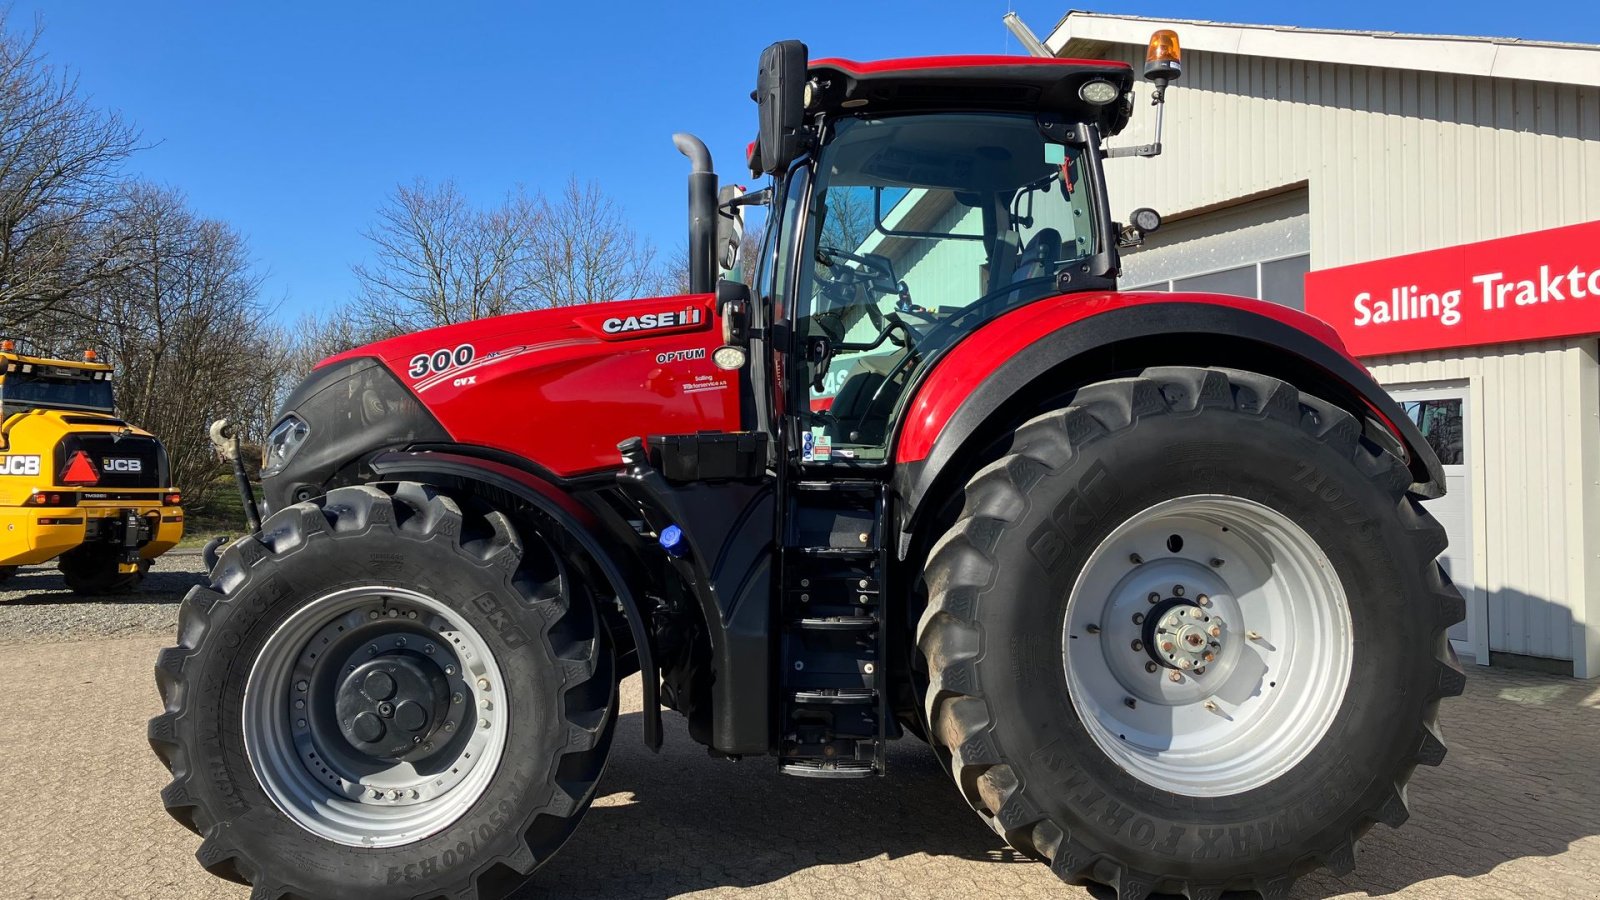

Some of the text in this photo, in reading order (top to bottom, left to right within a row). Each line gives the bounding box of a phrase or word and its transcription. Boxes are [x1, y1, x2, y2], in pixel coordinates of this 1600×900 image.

[1353, 265, 1600, 327] Salling Trakto
[602, 313, 674, 333] CASE
[408, 343, 475, 379] 300
[655, 348, 706, 365] OPTUM
[453, 375, 477, 387] CVX
[0, 456, 40, 475] JCB
[103, 459, 141, 471] JCB
[1023, 458, 1124, 574] BKT
[473, 590, 526, 651] BKT
